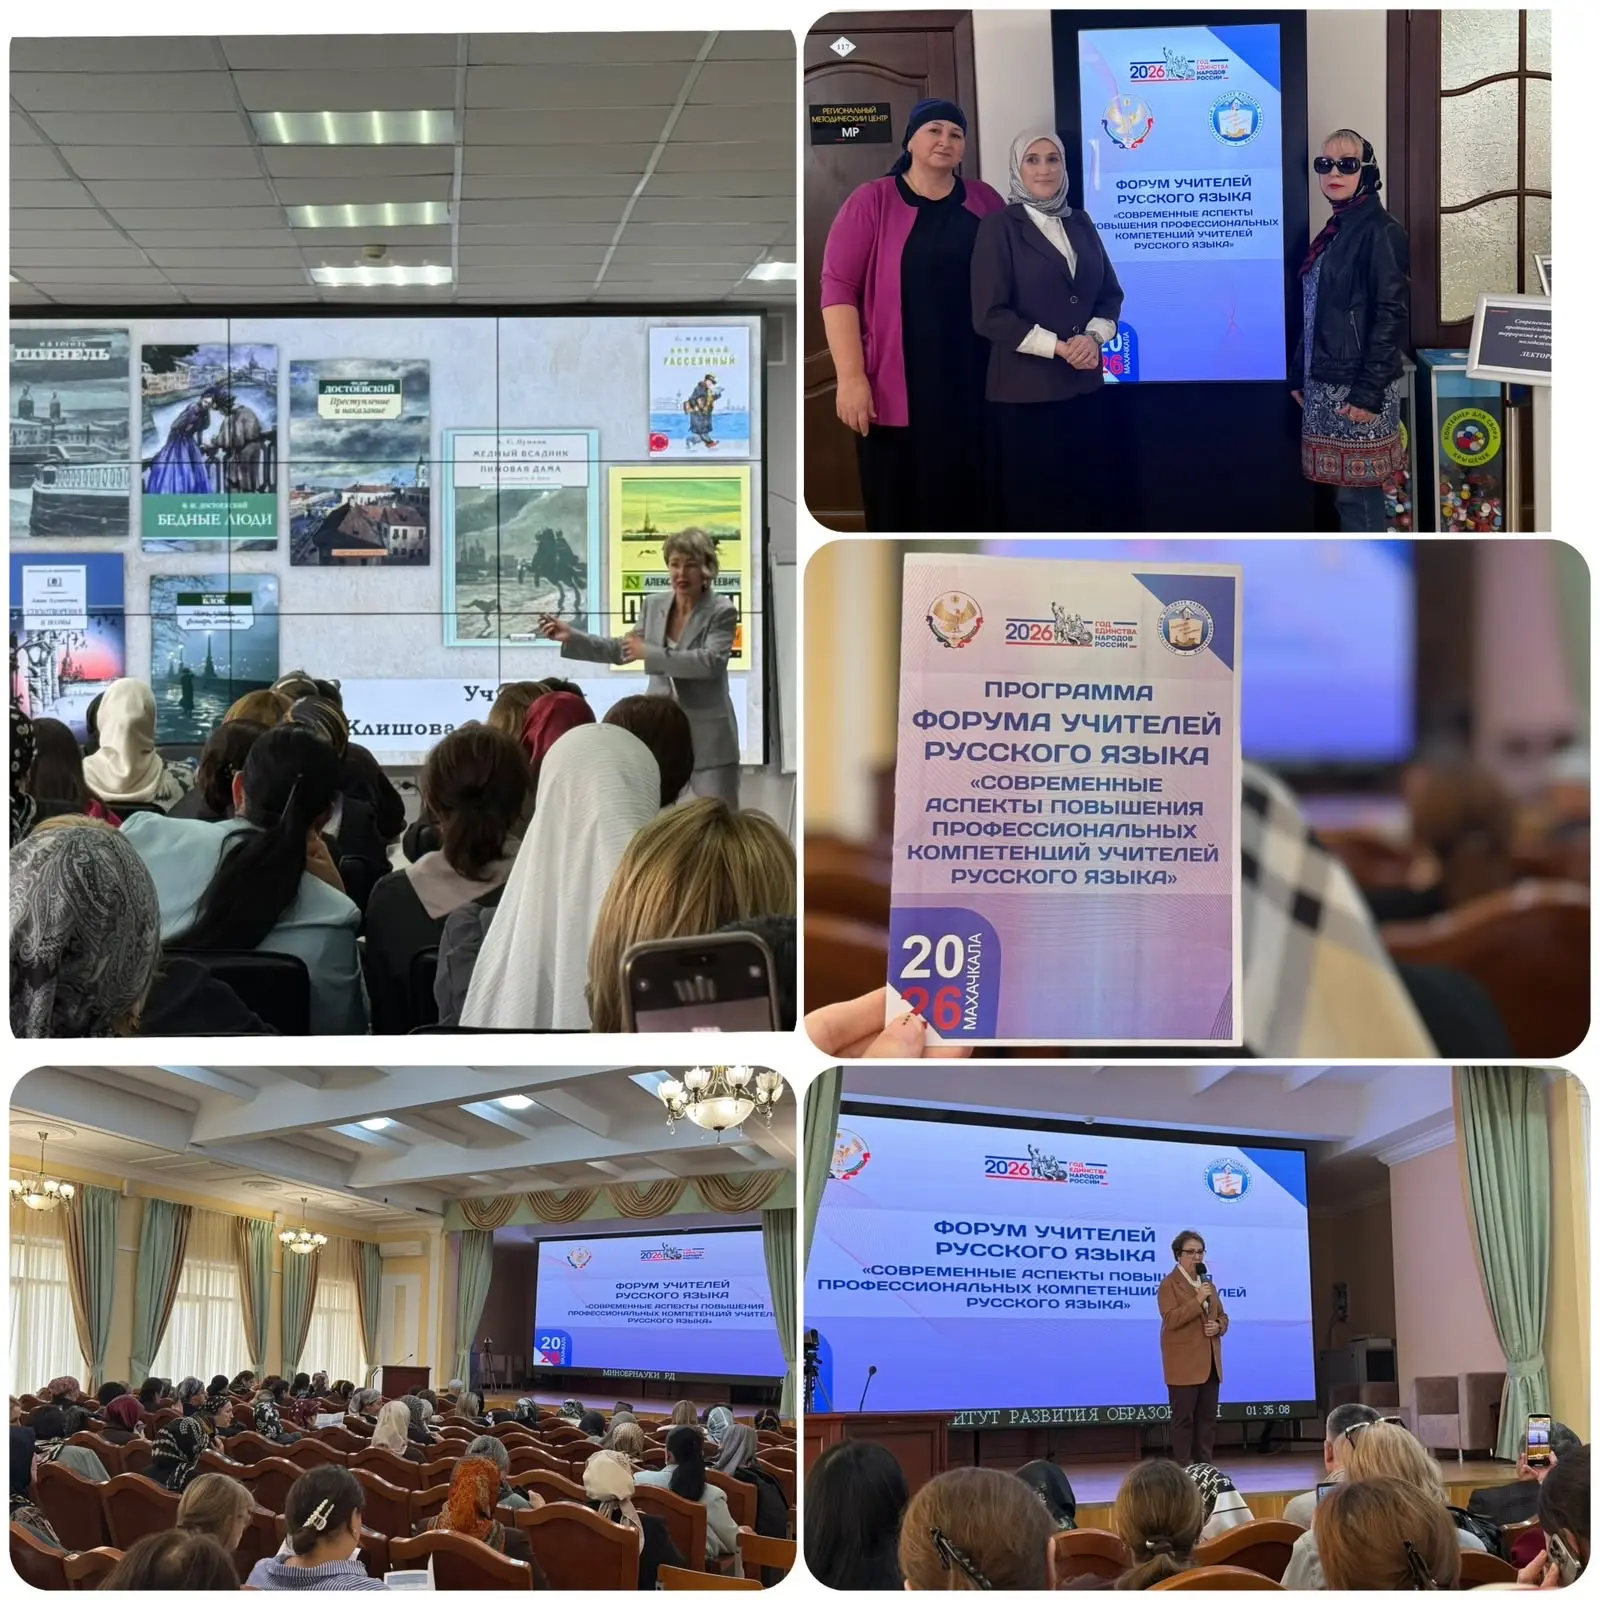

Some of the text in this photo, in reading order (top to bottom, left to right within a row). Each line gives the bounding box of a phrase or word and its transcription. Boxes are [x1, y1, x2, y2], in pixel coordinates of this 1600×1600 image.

[836, 43, 850, 51] 117
[1130, 65, 1165, 79] 2026
[822, 106, 877, 115] РЕГИОНАЛЬНЫЙ
[811, 114, 889, 124] МЕТОДИЧЕСКИЙ ЦЕНТР
[841, 127, 860, 138] МР
[1116, 175, 1252, 190] ФОРУМ УЧИТЕЛЕЙ
[1117, 191, 1252, 205] РУССКОГО ЯЗЫКА
[1113, 208, 1253, 219] «СОВРЕМЕННЫЕ АСПЕКТЫ
[1160, 218, 1279, 229] ПРОФЕССИОНАЛЬНЫХ
[1115, 229, 1253, 240] КОМПЕТЕНЦИЙ УЧИТЕЛЕЙ
[1134, 241, 1189, 250] РУССКОГО
[1123, 331, 1131, 375] МАХАЧКАЛА
[325, 384, 396, 394] ДОСТОЕВСКИЙ
[533, 465, 561, 473] ДАМА
[158, 513, 272, 527] БЕДНЫЕ ЛЮДИ
[1095, 620, 1112, 628] ГОД
[1005, 622, 1053, 641] 2026
[1095, 641, 1129, 649] РОССИИ
[985, 681, 1153, 702] ПРОГРАММА
[912, 709, 1221, 736] ФОРУМА УЧИТЕЛЕЙ
[924, 741, 1210, 766] РУССКОГО ЯЗЫКА
[970, 775, 1163, 793] «СОВРЕМЕННЫЕ
[925, 797, 1204, 816] АСПЕКТЫ ПОВЫШЕНИЯ
[932, 821, 1197, 839] ПРОФЕССИОНАЛЬНЫХ
[907, 841, 1219, 863] КОМПЕТЕНЦИЙ УЧИТЕЛЕЙ
[951, 868, 1178, 885] РУССКОГО ЯЗЫКА»
[900, 934, 964, 979] 20
[963, 932, 982, 1030] МАХАЧКАЛА
[985, 1159, 1030, 1176] 2026
[1069, 1167, 1107, 1175] ЕДИНСТВА
[934, 1220, 1155, 1243] ФОРУМ УЧИТЕЛЕЙ
[936, 1243, 1155, 1263] РУССКОГО ЯЗЫКА
[862, 1265, 1016, 1279] «СОВРЕМЕННЫЕ
[1022, 1269, 1104, 1281] АСПЕКТЫ
[615, 1279, 730, 1290] ФОРУМ УЧИТЕЛЕЙ
[818, 1279, 1158, 1297] ПРОФЕССИОНАЛЬНЫХ КОМПЕТЕНЦИЙ
[615, 1291, 729, 1300] РУССКОГО ЯЗЫКА
[966, 1297, 1131, 1310] РУССКОГО ЯЗЫКА»
[662, 1310, 731, 1318] КОМПЕТЕНЦИЙ
[541, 1336, 560, 1350] 20
[665, 1371, 675, 1381] РД
[1009, 1407, 1099, 1425] РАЗВИТИЯ
